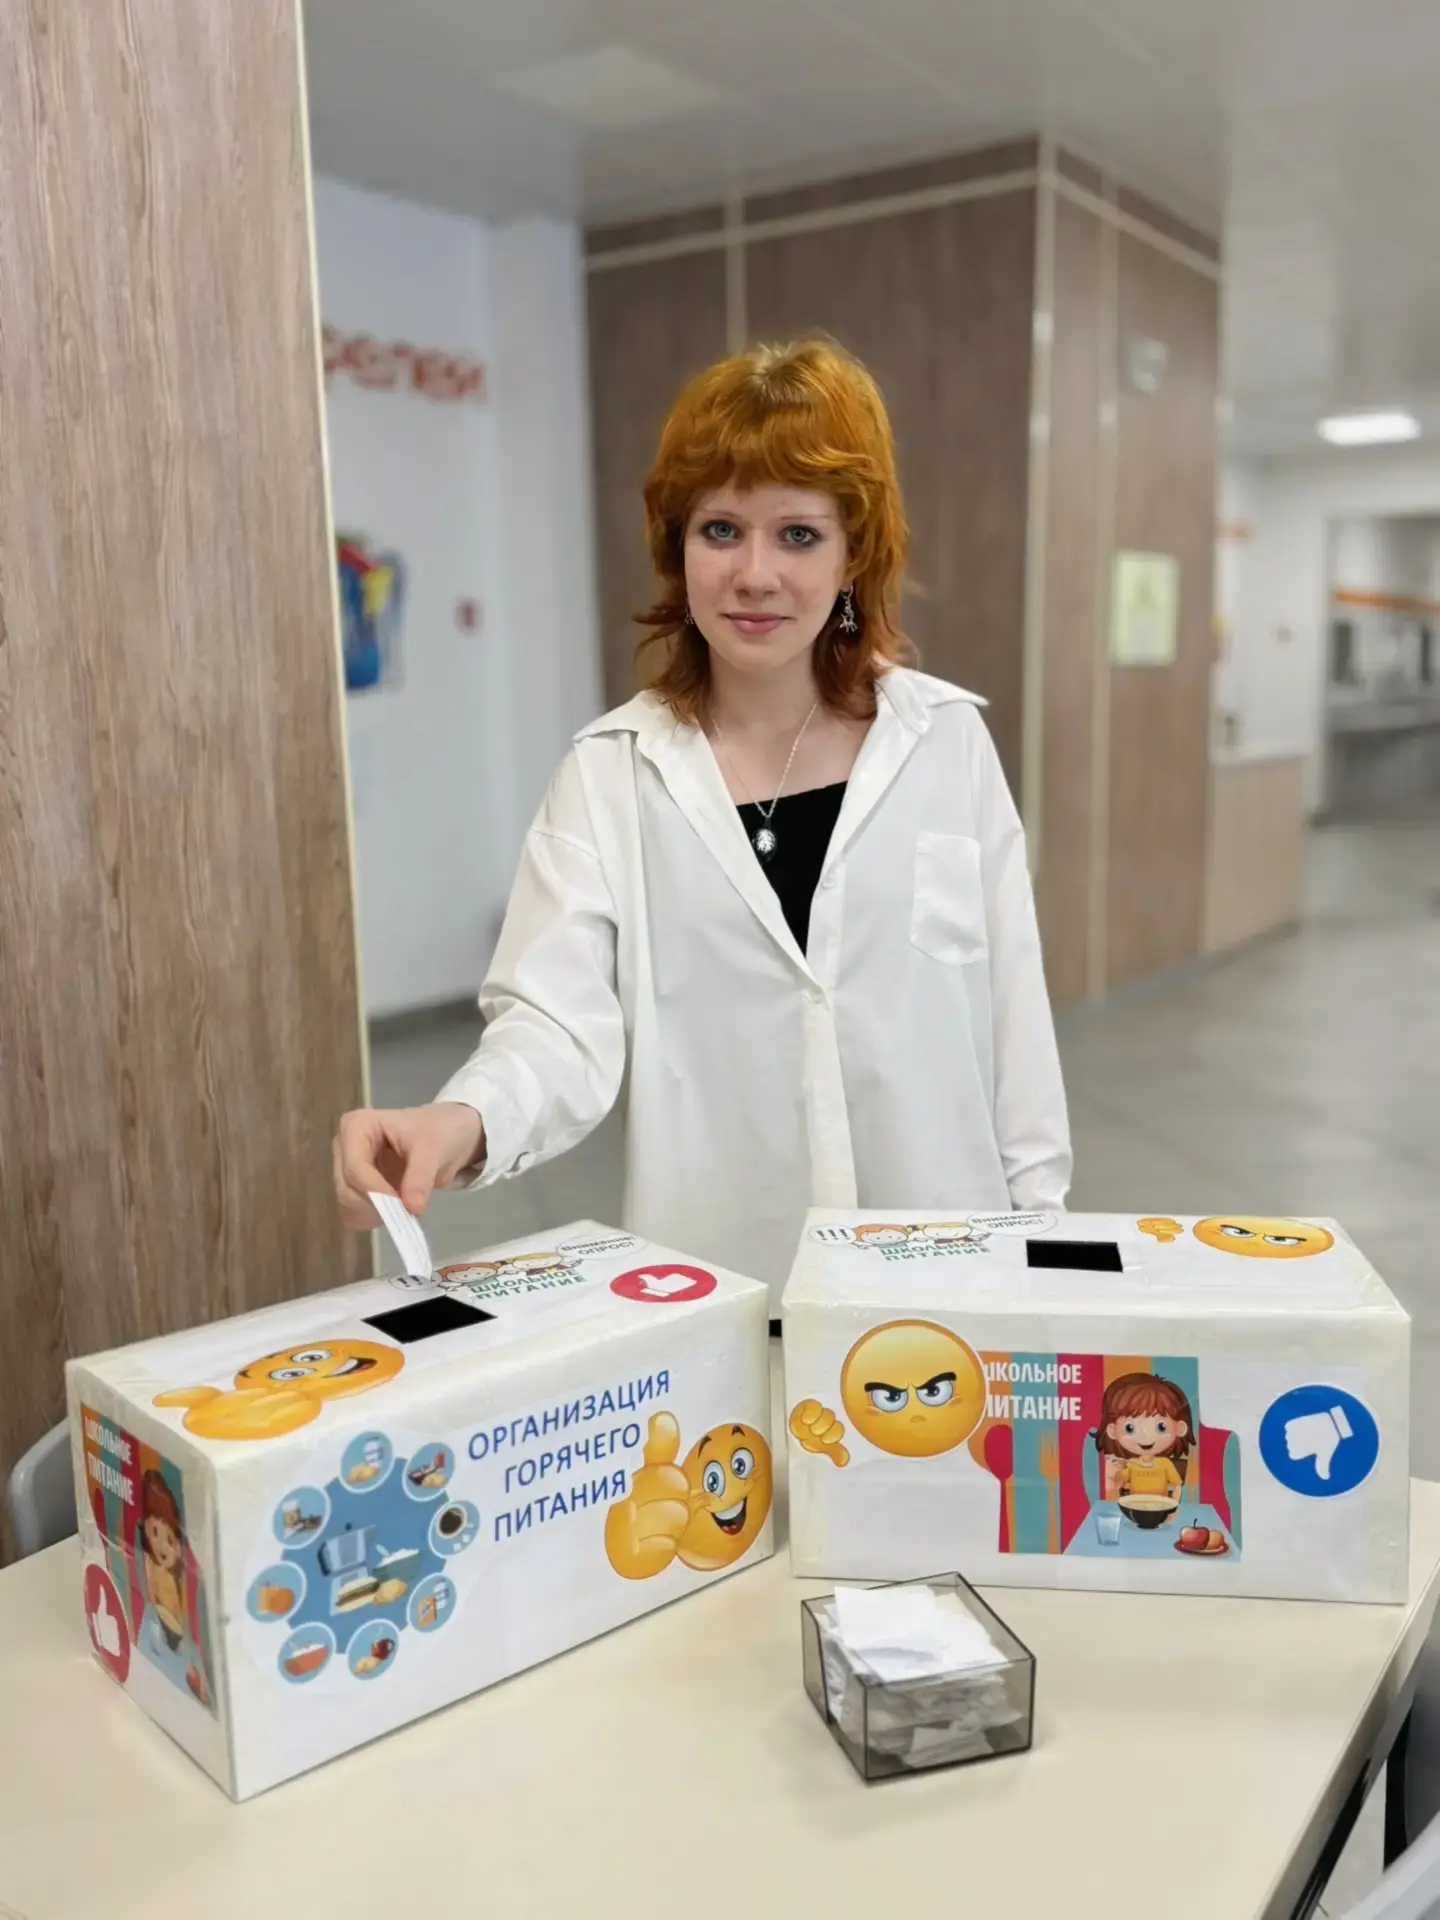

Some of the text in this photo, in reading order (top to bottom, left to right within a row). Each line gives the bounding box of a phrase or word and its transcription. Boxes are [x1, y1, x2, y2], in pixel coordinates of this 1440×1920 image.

[987, 1219, 1044, 1230] ОПРОС!
[578, 1242, 634, 1256] ОПРОС!
[881, 1242, 982, 1256] ШКОЛЬНОЕ
[885, 1247, 991, 1262] ПИТАНИЕ
[470, 1268, 577, 1294] ШКОЛЬНОЕ
[476, 1275, 587, 1300] ПИТАНИЕ
[468, 1370, 669, 1460] ОРГАНИЗАЦИЯ
[84, 1416, 133, 1466] ШКОЛЬНОЕ
[505, 1423, 641, 1494] ГОРЯЧЕГО
[88, 1451, 134, 1507] ПИТАНИЕ
[494, 1469, 626, 1542] ПИТАНИЯ
